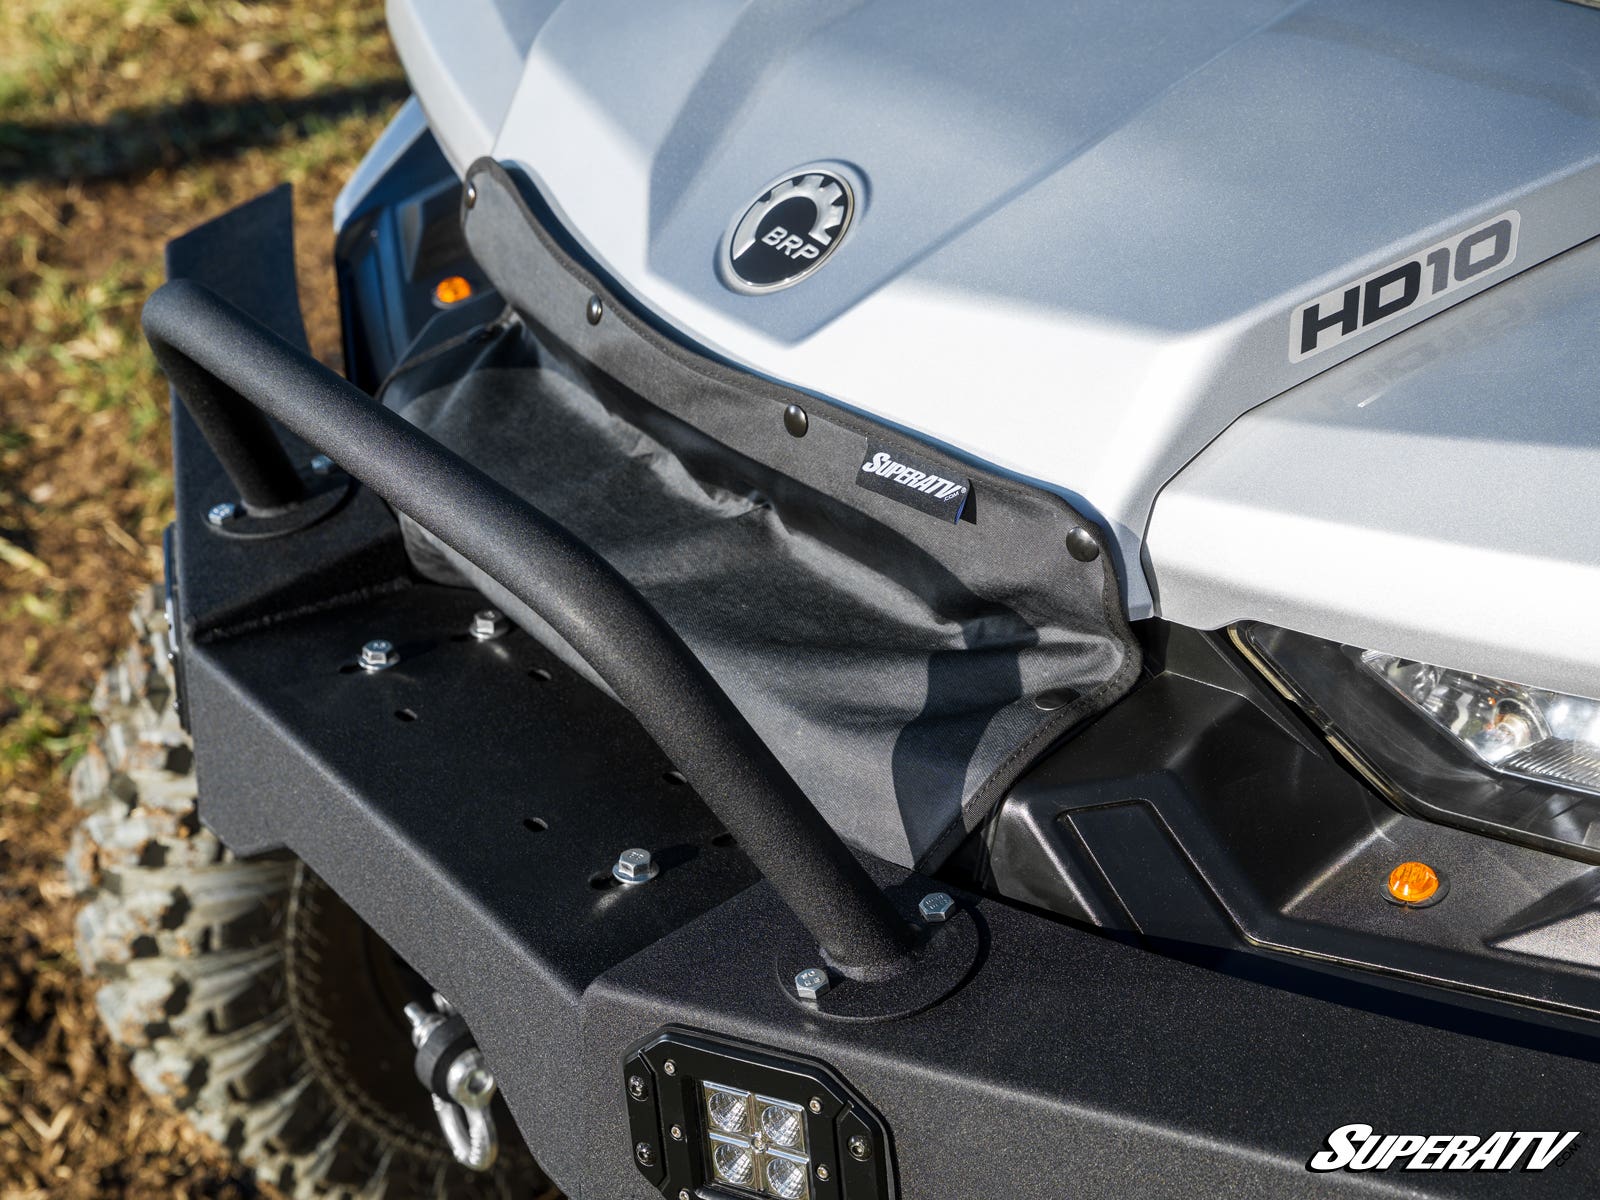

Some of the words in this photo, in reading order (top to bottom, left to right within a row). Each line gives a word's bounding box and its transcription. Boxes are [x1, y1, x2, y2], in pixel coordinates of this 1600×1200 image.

[761, 226, 820, 260] BRP
[1300, 219, 1512, 354] HD10
[861, 452, 963, 499] SUPERATV
